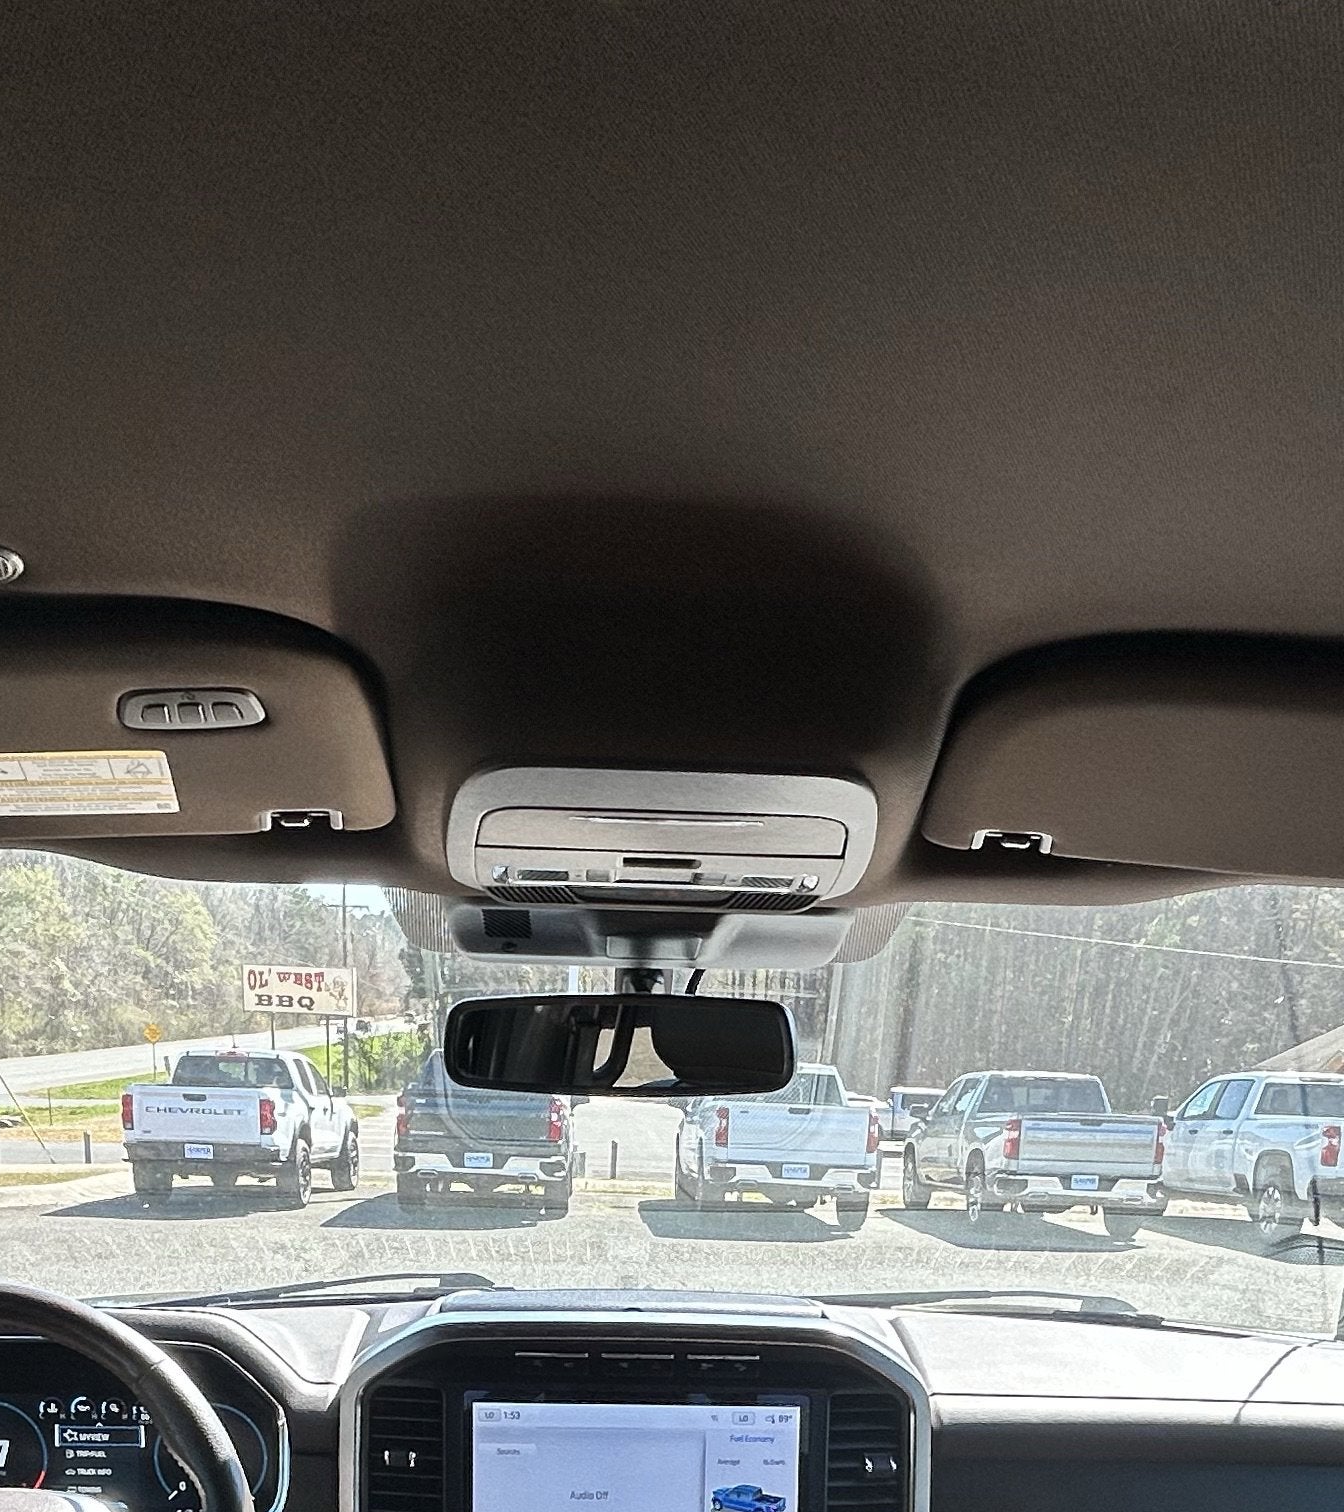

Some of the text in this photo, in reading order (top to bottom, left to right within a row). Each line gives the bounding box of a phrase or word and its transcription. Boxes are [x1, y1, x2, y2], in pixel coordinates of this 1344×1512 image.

[247, 968, 325, 992] OL' WEST
[255, 994, 316, 1011] BBQ
[145, 1106, 245, 1116] CHEVROLET
[569, 1490, 594, 1500] Audio
